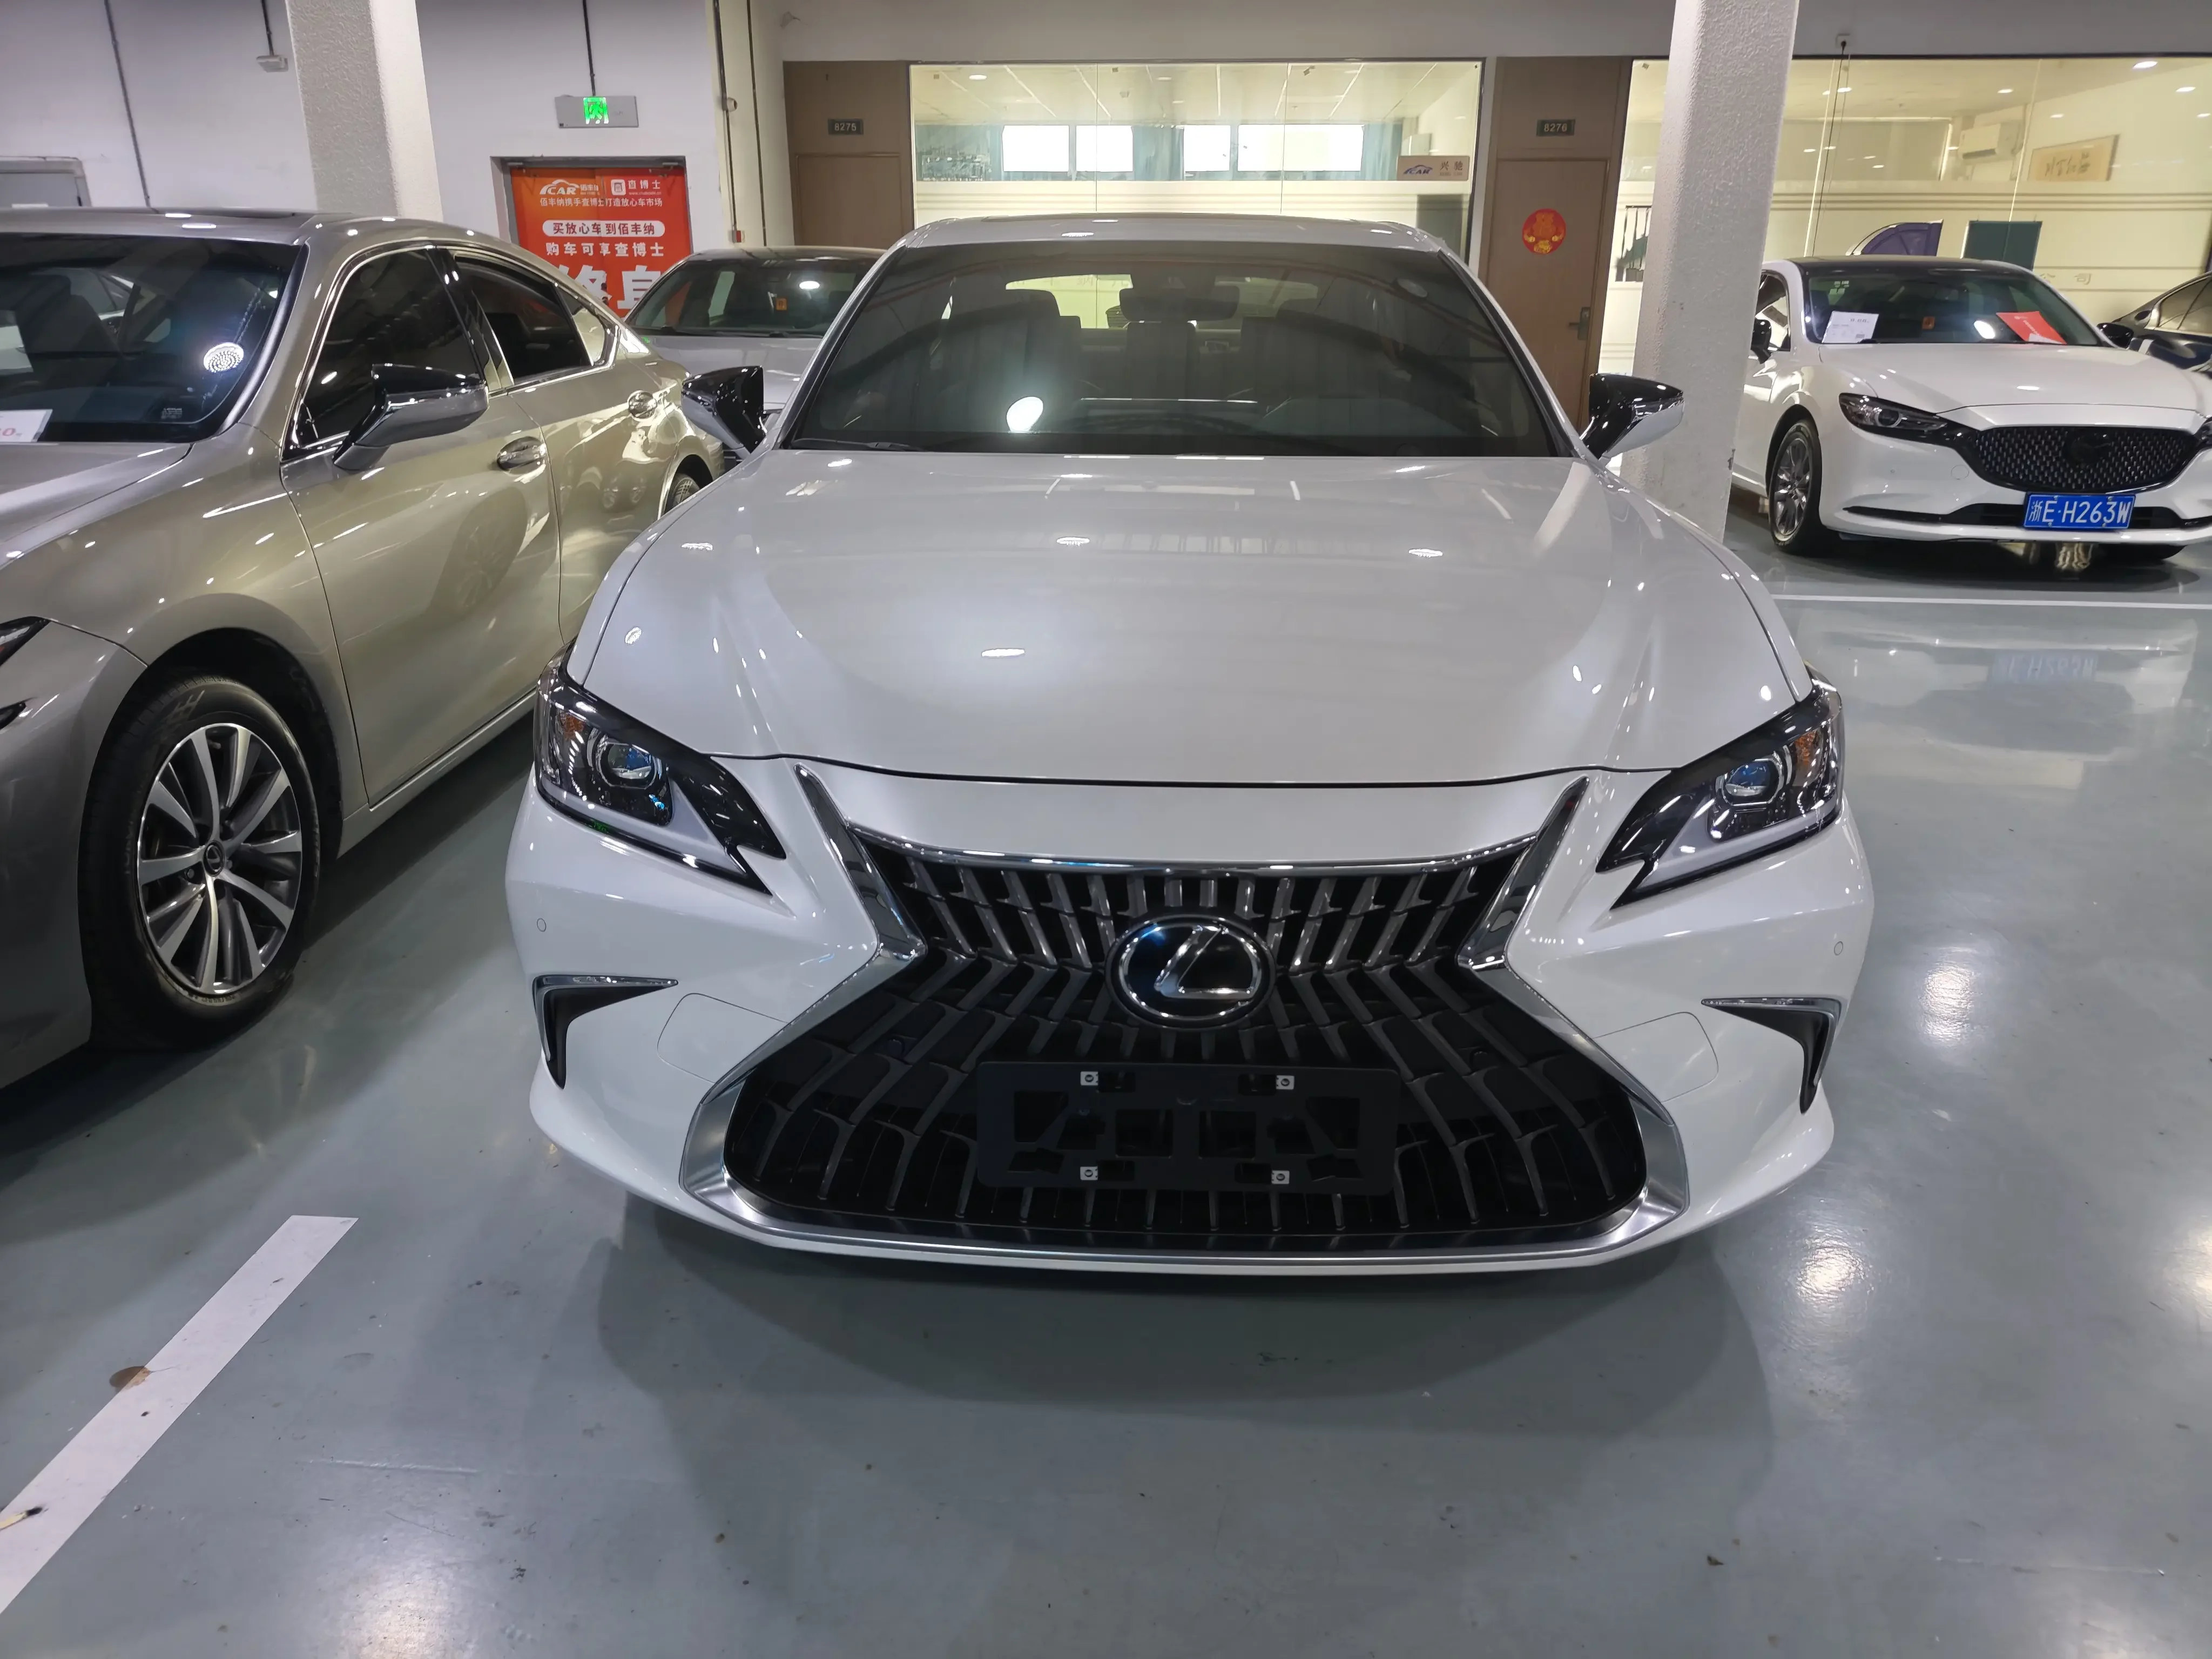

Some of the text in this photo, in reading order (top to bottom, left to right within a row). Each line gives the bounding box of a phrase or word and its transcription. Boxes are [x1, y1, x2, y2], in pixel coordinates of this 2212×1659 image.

[553, 222, 655, 235] 买放心车到佰丰纳
[545, 242, 664, 258] 购车可享查博士
